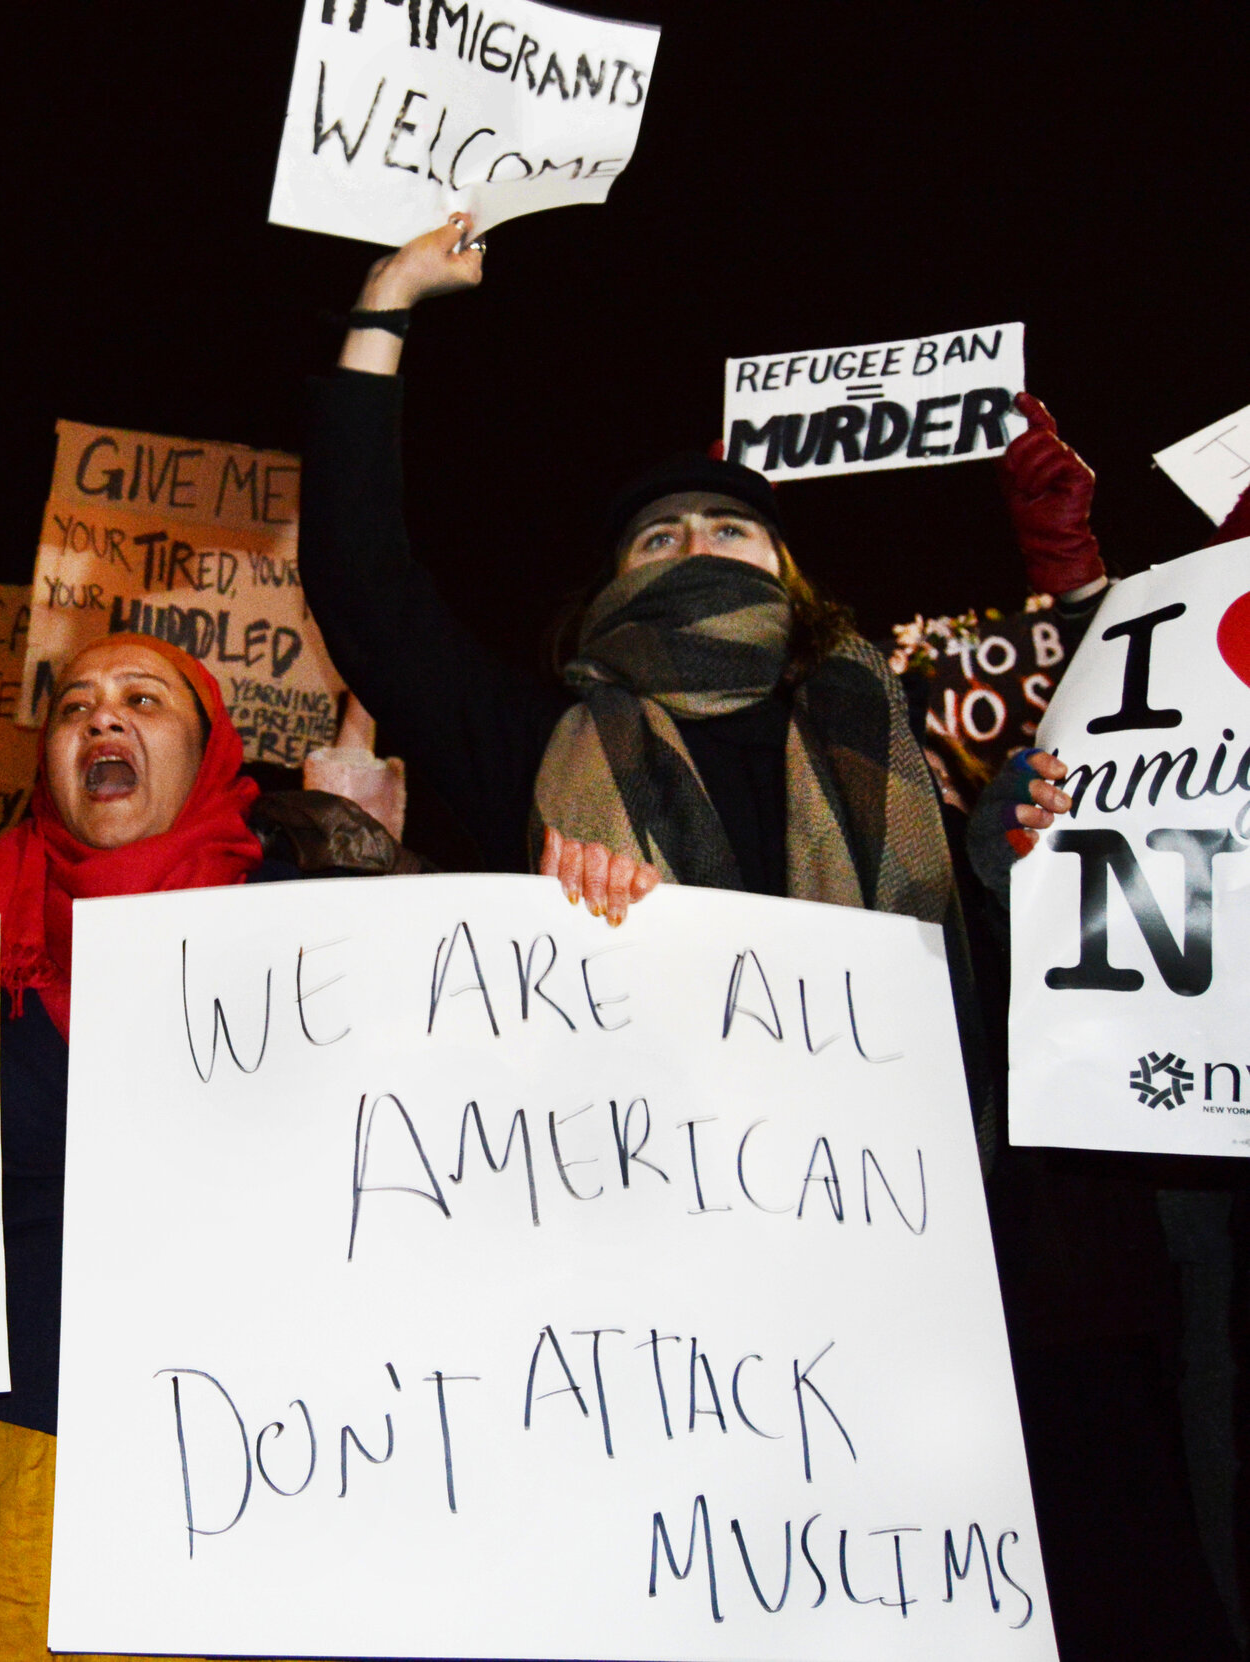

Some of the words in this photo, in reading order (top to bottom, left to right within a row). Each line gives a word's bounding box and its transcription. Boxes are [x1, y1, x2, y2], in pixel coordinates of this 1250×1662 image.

[312, 60, 628, 191] WELCOME
[736, 347, 904, 392] REFUGEE
[912, 329, 1002, 376] BAN
[75, 435, 205, 508] GIVE
[214, 456, 300, 525] ME
[726, 385, 1016, 471] MURDER
[54, 513, 128, 570] YOUR
[134, 531, 238, 598] TIRED,
[44, 575, 105, 610] YOUR
[109, 595, 303, 678] HUDDLED
[1086, 602, 1187, 734] I
[180, 937, 352, 1084] WE
[426, 921, 638, 1038] ARE
[720, 947, 904, 1063] ALL
[1203, 1105, 1224, 1114] NEW
[347, 1091, 928, 1264] AMERICAN
[152, 1361, 481, 1561] DON'T
[523, 1324, 857, 1484] ATTACK
[647, 1493, 1035, 1630] MUSLIMS
